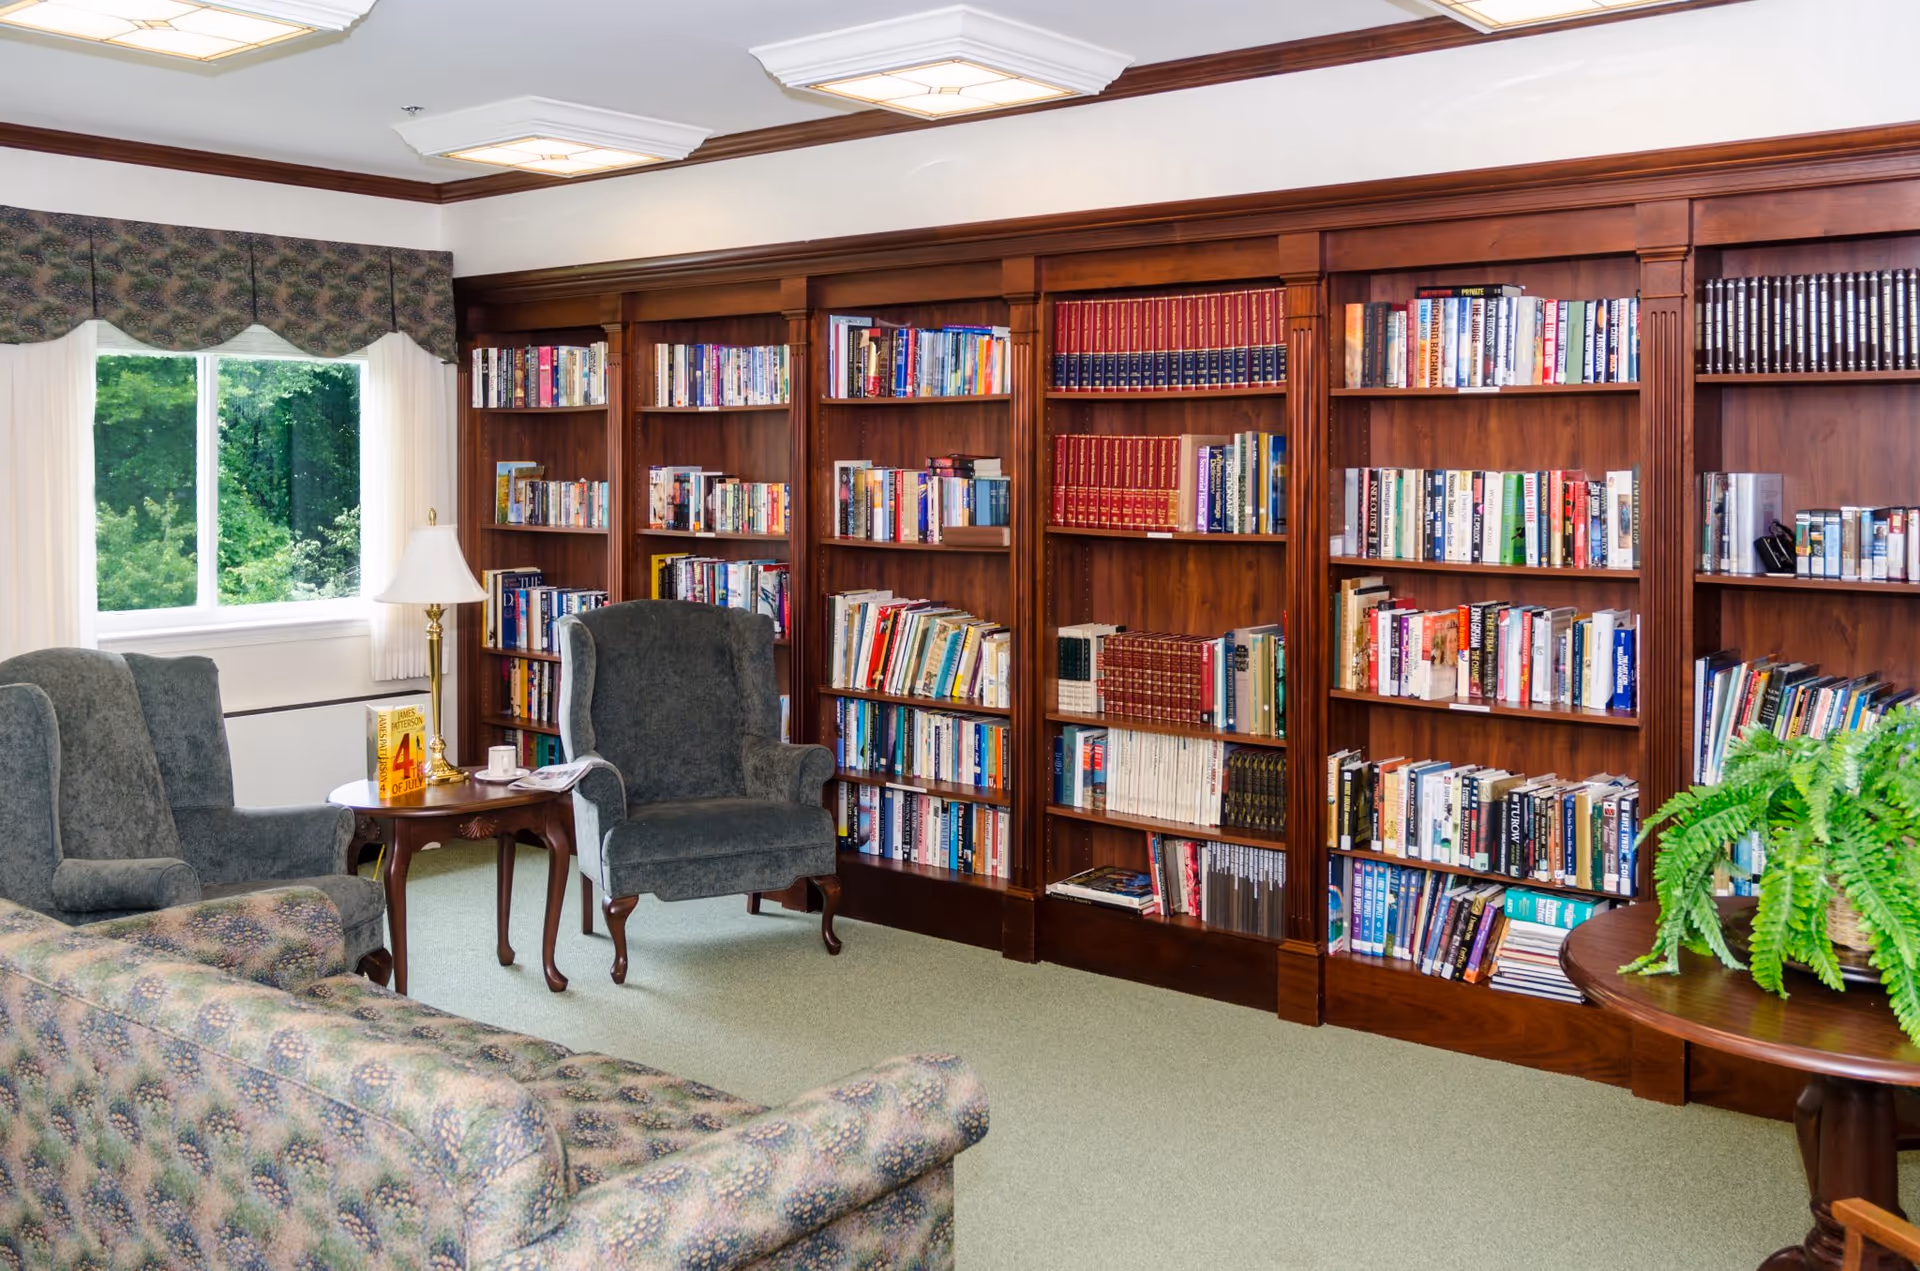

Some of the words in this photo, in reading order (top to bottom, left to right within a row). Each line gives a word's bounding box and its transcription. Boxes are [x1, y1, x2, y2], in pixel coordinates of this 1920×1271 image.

[1461, 287, 1485, 296] PRIVATE
[1472, 303, 1482, 317] THE
[1486, 300, 1497, 317] JACK
[1430, 299, 1440, 340] RICHARD
[1472, 319, 1482, 344] JUDGE
[1486, 318, 1496, 346] HIGGINS
[1430, 342, 1440, 388] BACHMAN
[1526, 478, 1534, 498] TRIAL
[1526, 507, 1535, 524] FIRE
[1470, 607, 1482, 623] JOHN
[1487, 614, 1495, 630] THE
[1470, 623, 1480, 648] GRISHAM
[1486, 632, 1495, 652] FIRM
[1472, 650, 1480, 660] THE
[392, 716, 423, 732] PATTERSON
[398, 707, 416, 721] JAMES
[379, 714, 388, 738] JAMES
[379, 739, 388, 782] PATTERSON
[393, 732, 414, 780] 4
[380, 784, 386, 792] 4
[392, 782, 404, 795] OF
[404, 774, 425, 792] JULY
[1511, 803, 1521, 843] TUROW
[1622, 812, 1630, 832] GAYLE
[1621, 834, 1630, 854] LYNDS
[1364, 900, 1372, 918] PEOPLES
[1376, 901, 1384, 918] PEOPLES
